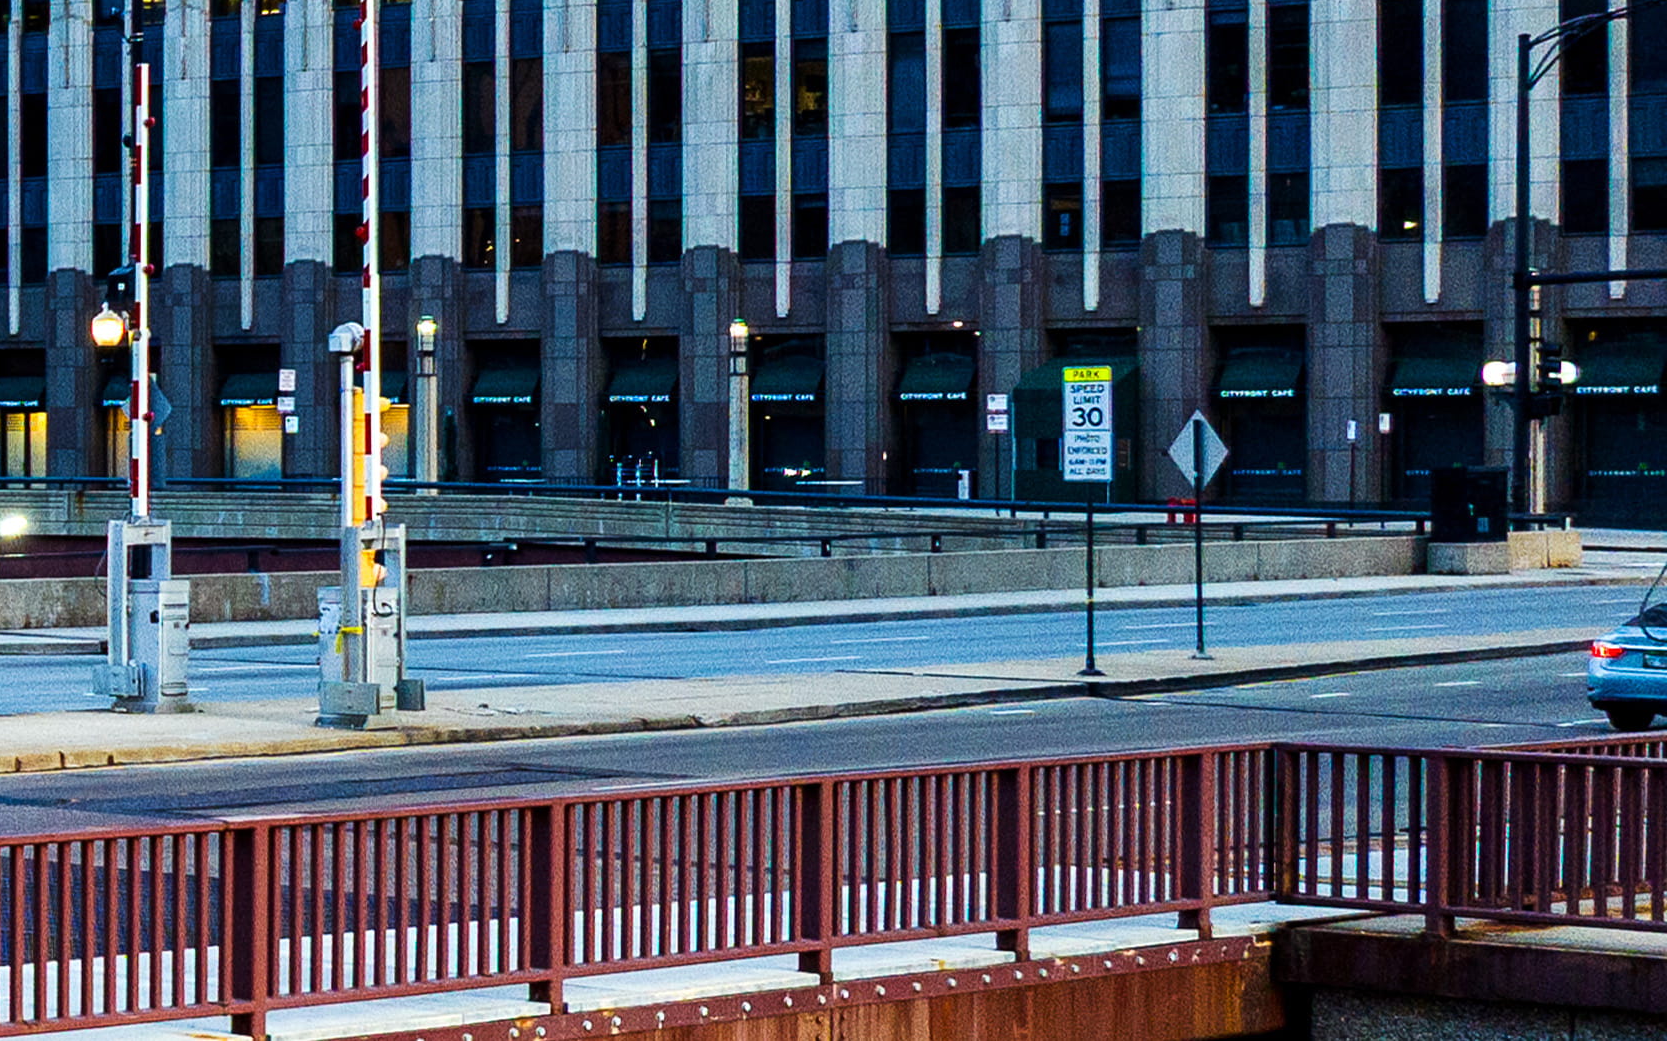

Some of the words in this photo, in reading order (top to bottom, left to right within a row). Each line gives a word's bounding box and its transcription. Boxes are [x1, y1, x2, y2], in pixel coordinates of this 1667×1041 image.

[1073, 370, 1100, 379] PARK
[1070, 384, 1104, 394] SPEED
[1073, 395, 1101, 405] LIMIT
[1072, 407, 1103, 427] 30
